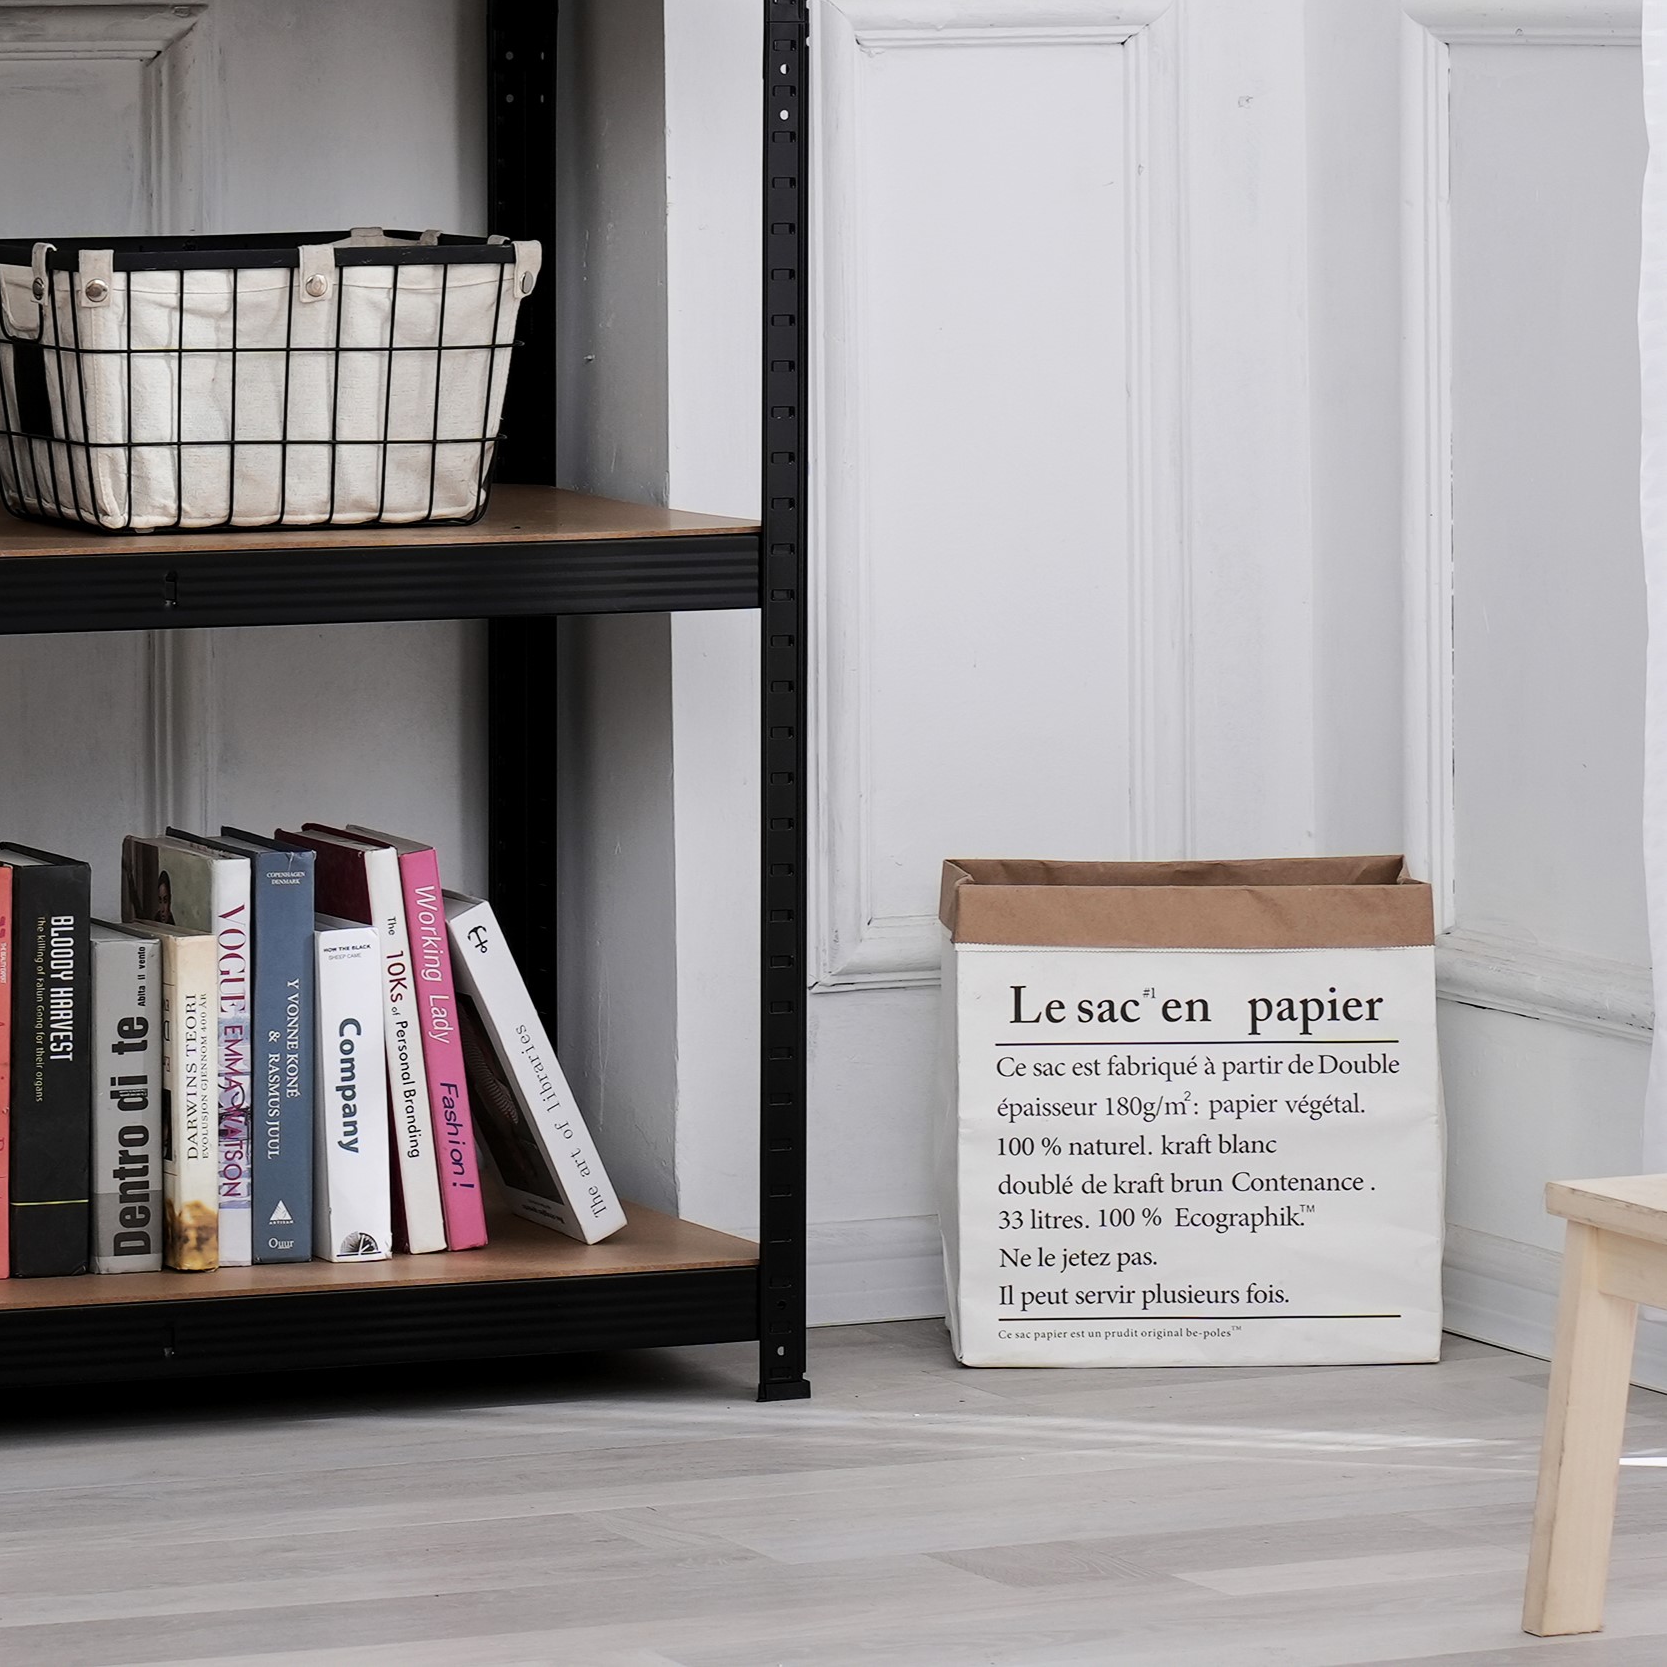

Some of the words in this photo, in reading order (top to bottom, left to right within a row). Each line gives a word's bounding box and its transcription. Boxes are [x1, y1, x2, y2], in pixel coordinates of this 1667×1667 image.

[50, 916, 74, 980] BLOODY
[387, 917, 396, 935] The
[415, 886, 444, 982] Working
[218, 903, 246, 1013] VOGUE
[386, 951, 408, 1002] 10Ks
[50, 988, 74, 1061] HARVEST
[185, 994, 197, 1055] TEORI
[287, 979, 299, 1050] YVONNE
[392, 1007, 400, 1016] of
[429, 995, 455, 1044] Lady
[1010, 985, 1066, 1024] Le
[1077, 997, 1140, 1023] sac
[1161, 996, 1212, 1022] en
[1248, 987, 1383, 1036] papier
[112, 1016, 149, 1055] te
[269, 1031, 280, 1042] &
[396, 1021, 416, 1086] Personal
[224, 1025, 244, 1092] EMMA
[286, 1054, 300, 1098] KONÉ
[516, 1024, 561, 1112] libraries
[996, 1056, 1027, 1078] Ce
[1033, 1061, 1066, 1077] sac
[1072, 1058, 1101, 1076] est
[1107, 1054, 1198, 1082] fabriqué
[1204, 1055, 1216, 1075] à
[1222, 1054, 1283, 1081] partir
[1288, 1054, 1314, 1074] de
[1318, 1053, 1400, 1074] Double
[110, 1075, 148, 1111] di
[268, 1053, 280, 1118] RASMUS
[336, 1018, 361, 1154] Company
[997, 1097, 1097, 1123] épaisseur
[1210, 1094, 1277, 1120] papier
[1285, 1092, 1366, 1117] végétal.
[187, 1062, 198, 1160] DARWINS
[404, 1089, 421, 1158] Branding
[554, 1121, 573, 1140] of
[223, 1103, 244, 1196] WATSON
[267, 1120, 280, 1160] JUUL
[570, 1148, 591, 1176] art
[998, 1137, 1034, 1156] 100
[1041, 1136, 1062, 1155] %
[1069, 1135, 1153, 1156] naturel.
[1161, 1134, 1213, 1155] kraft
[1218, 1133, 1277, 1154] blanc
[113, 1125, 151, 1256] Dentro
[588, 1186, 606, 1218] The
[998, 1175, 1073, 1195] doublé
[1082, 1175, 1107, 1194] de
[1113, 1173, 1165, 1194] kraft
[1170, 1173, 1223, 1192] brun
[1232, 1172, 1364, 1192] Contenance
[998, 1211, 1024, 1230] 33
[1030, 1209, 1090, 1229] litres.
[1098, 1208, 1134, 1227] 100
[1142, 1208, 1162, 1227] %
[268, 1238, 294, 1250] Ouur
[998, 1247, 1032, 1268] Ne
[1038, 1246, 1056, 1267] le
[1060, 1248, 1111, 1273] jetez
[1116, 1249, 1158, 1271] pas.
[998, 1285, 1014, 1305] Il
[1020, 1288, 1069, 1311] peut
[1075, 1285, 1136, 1305] servir
[1141, 1284, 1240, 1310] plusieurs
[1246, 1282, 1290, 1303] fois.
[998, 1329, 1011, 1339] Ce
[1015, 1331, 1031, 1339] sac
[1034, 1328, 1066, 1341] papier
[1070, 1329, 1085, 1339] est
[1088, 1331, 1102, 1339] un
[1105, 1328, 1138, 1341] prudit
[1140, 1327, 1183, 1341] original
